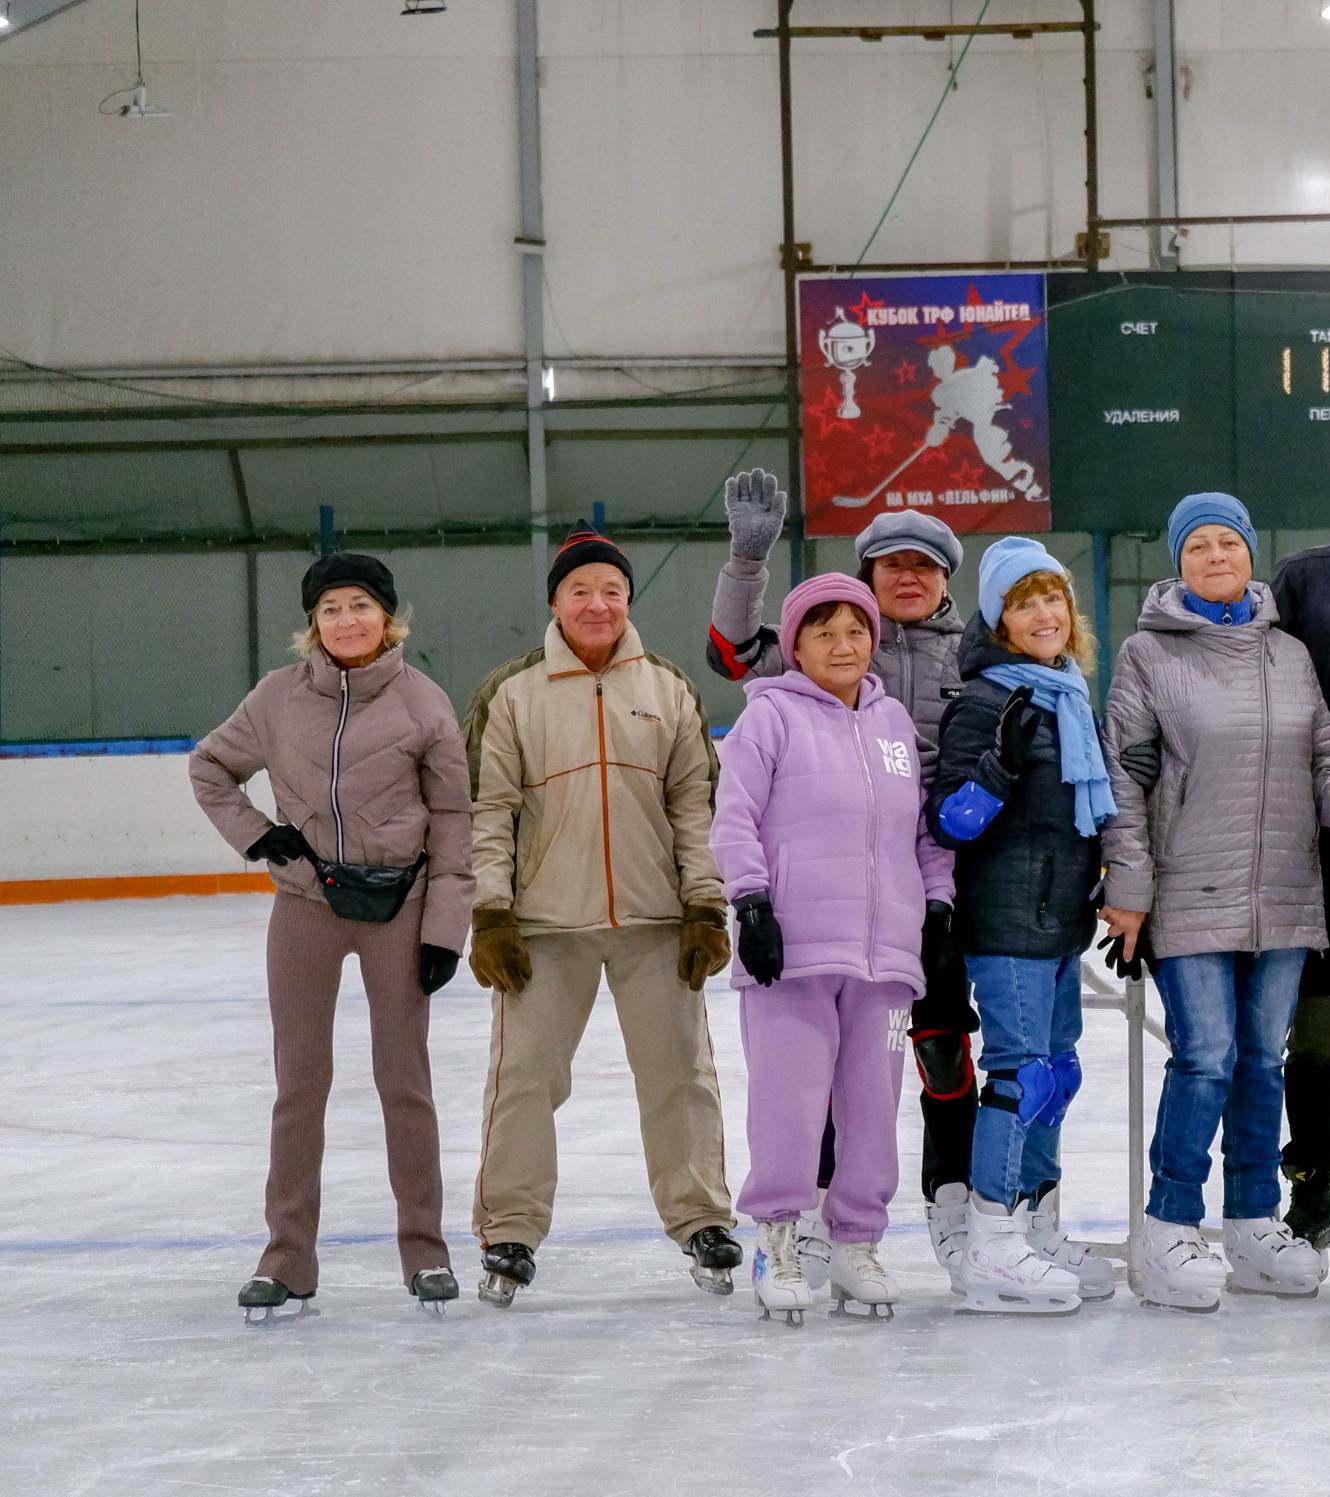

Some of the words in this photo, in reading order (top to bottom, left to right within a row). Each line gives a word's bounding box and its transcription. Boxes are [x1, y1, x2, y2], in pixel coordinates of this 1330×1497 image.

[867, 306, 918, 326] КУБОК
[922, 305, 955, 324] ТРФ
[959, 300, 1031, 323] ЮНАЙТЕД
[1120, 322, 1158, 335] СЧЕТ
[1103, 409, 1179, 425] УДАЛЕНИЯ
[886, 492, 904, 507] НА
